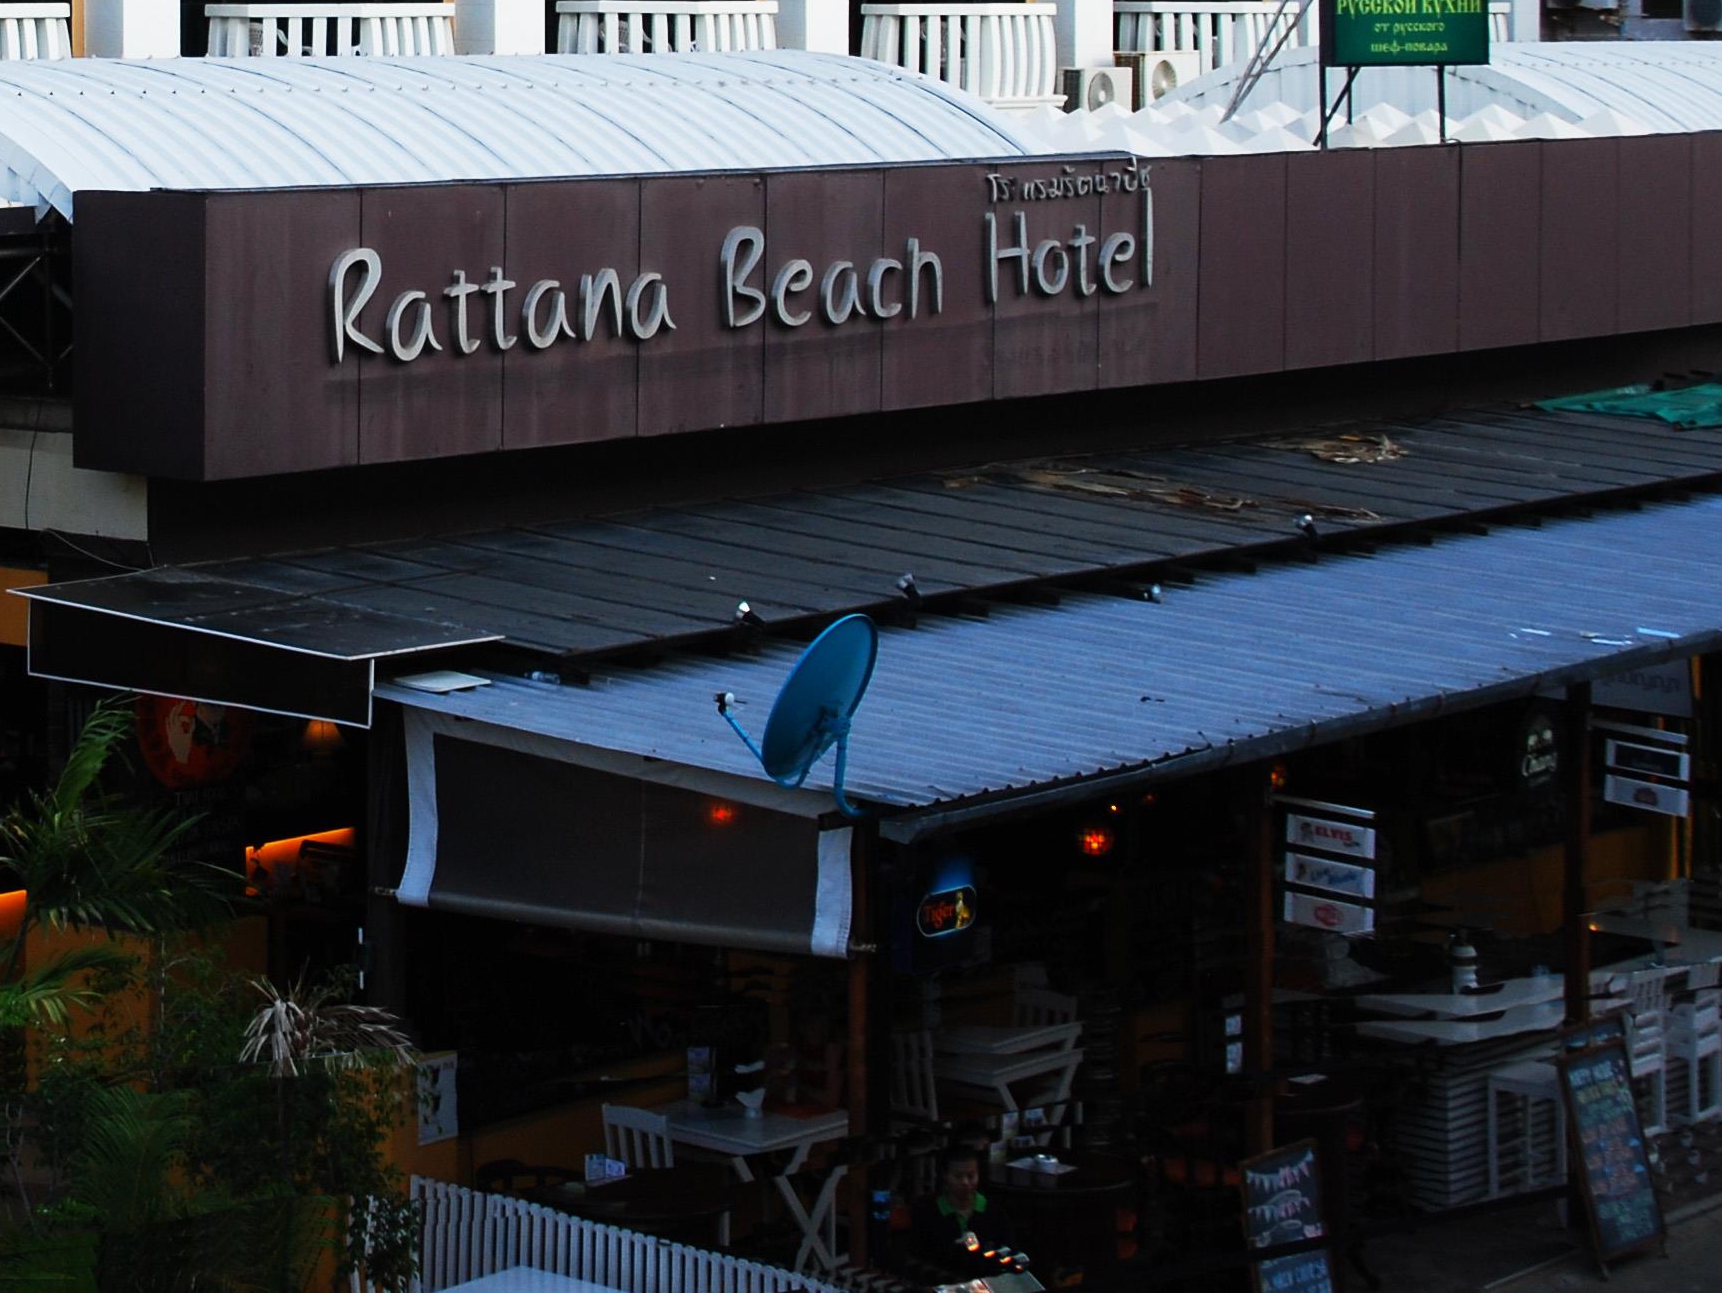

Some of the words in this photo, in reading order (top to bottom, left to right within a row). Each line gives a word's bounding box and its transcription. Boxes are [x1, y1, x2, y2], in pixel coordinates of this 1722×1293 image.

[329, 247, 676, 364] Rattana
[721, 225, 942, 328] Beach
[984, 188, 1155, 303] Hotel
